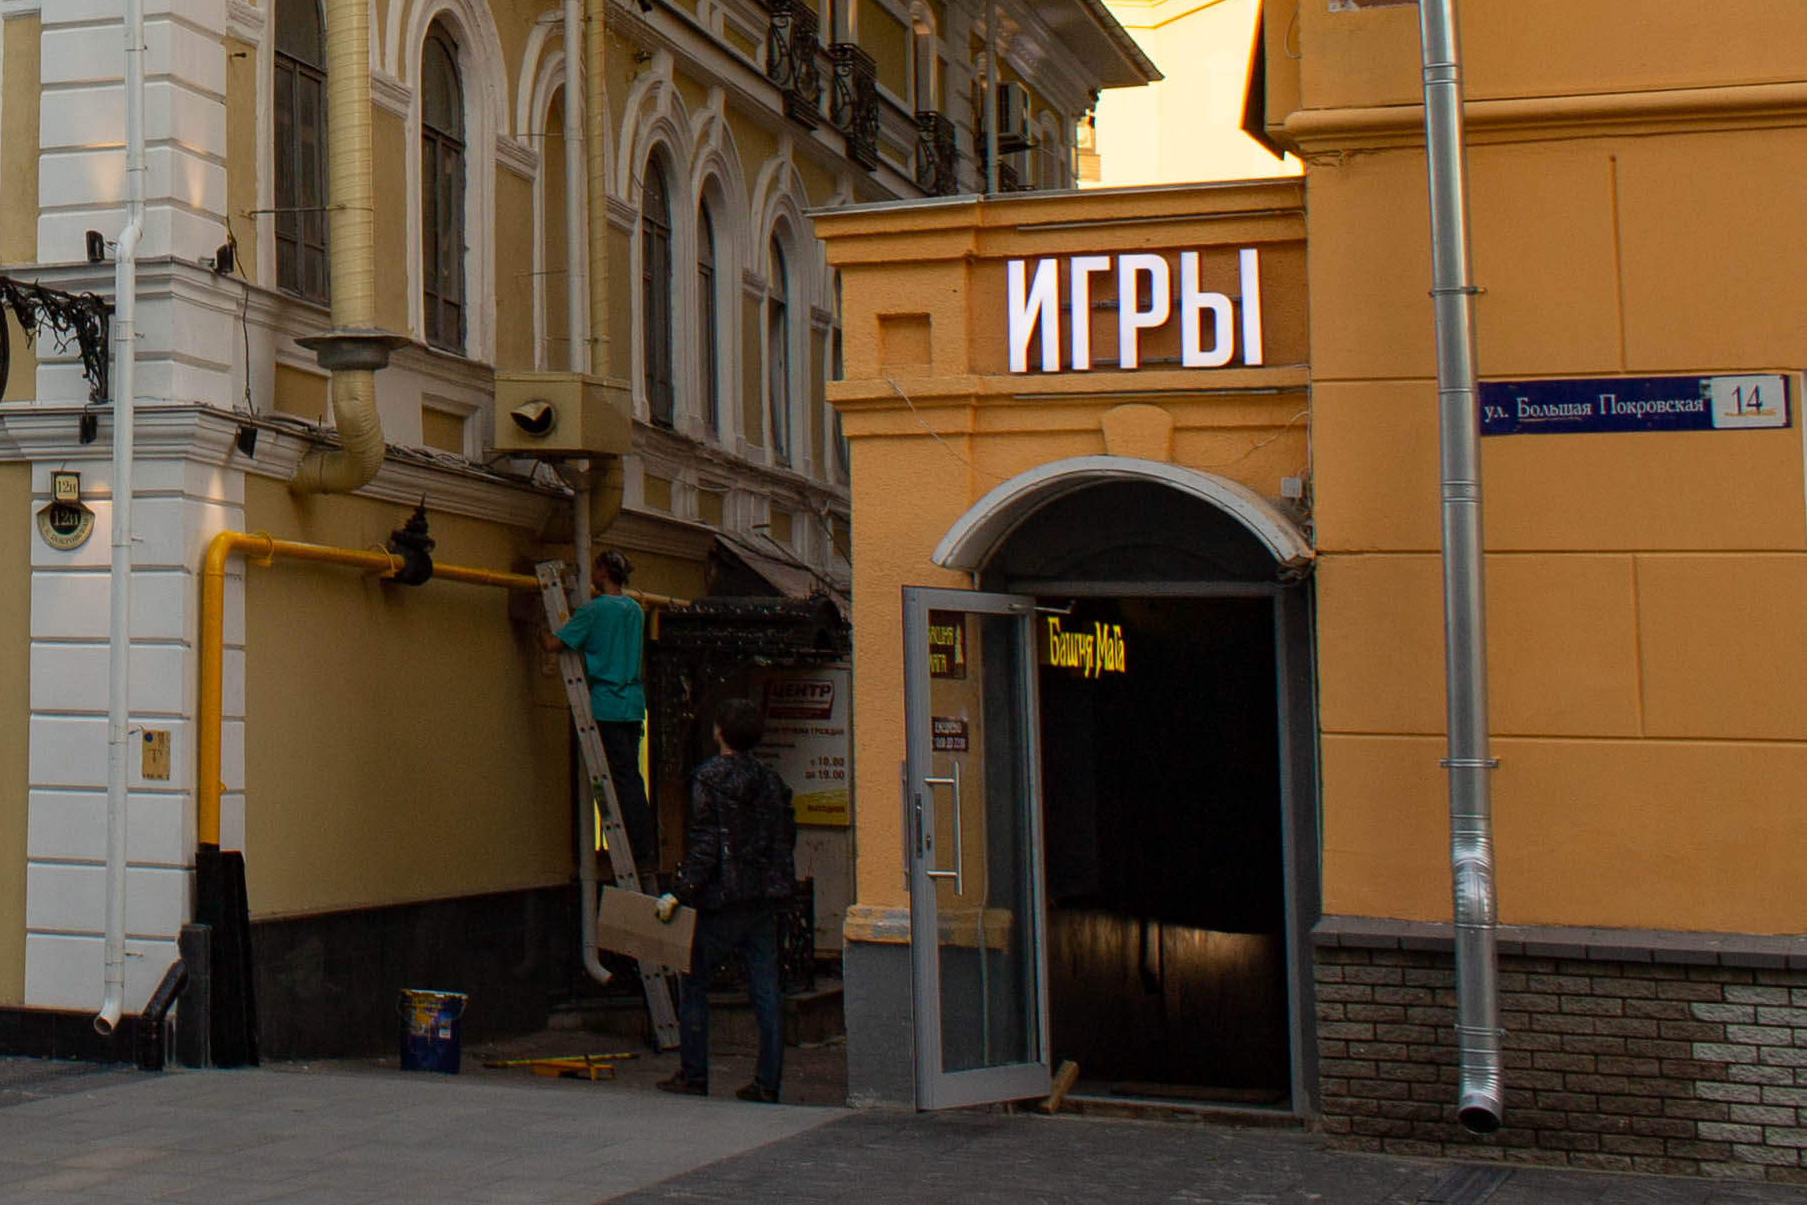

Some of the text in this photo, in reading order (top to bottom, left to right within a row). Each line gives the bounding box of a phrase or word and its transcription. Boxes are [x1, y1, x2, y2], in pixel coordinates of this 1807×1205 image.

[1006, 248, 1264, 373] ИГРЫ
[1484, 384, 1762, 421] ул. Большая Покровская 14
[1047, 616, 1094, 679] Башня
[771, 683, 831, 698] ЦЕНТР
